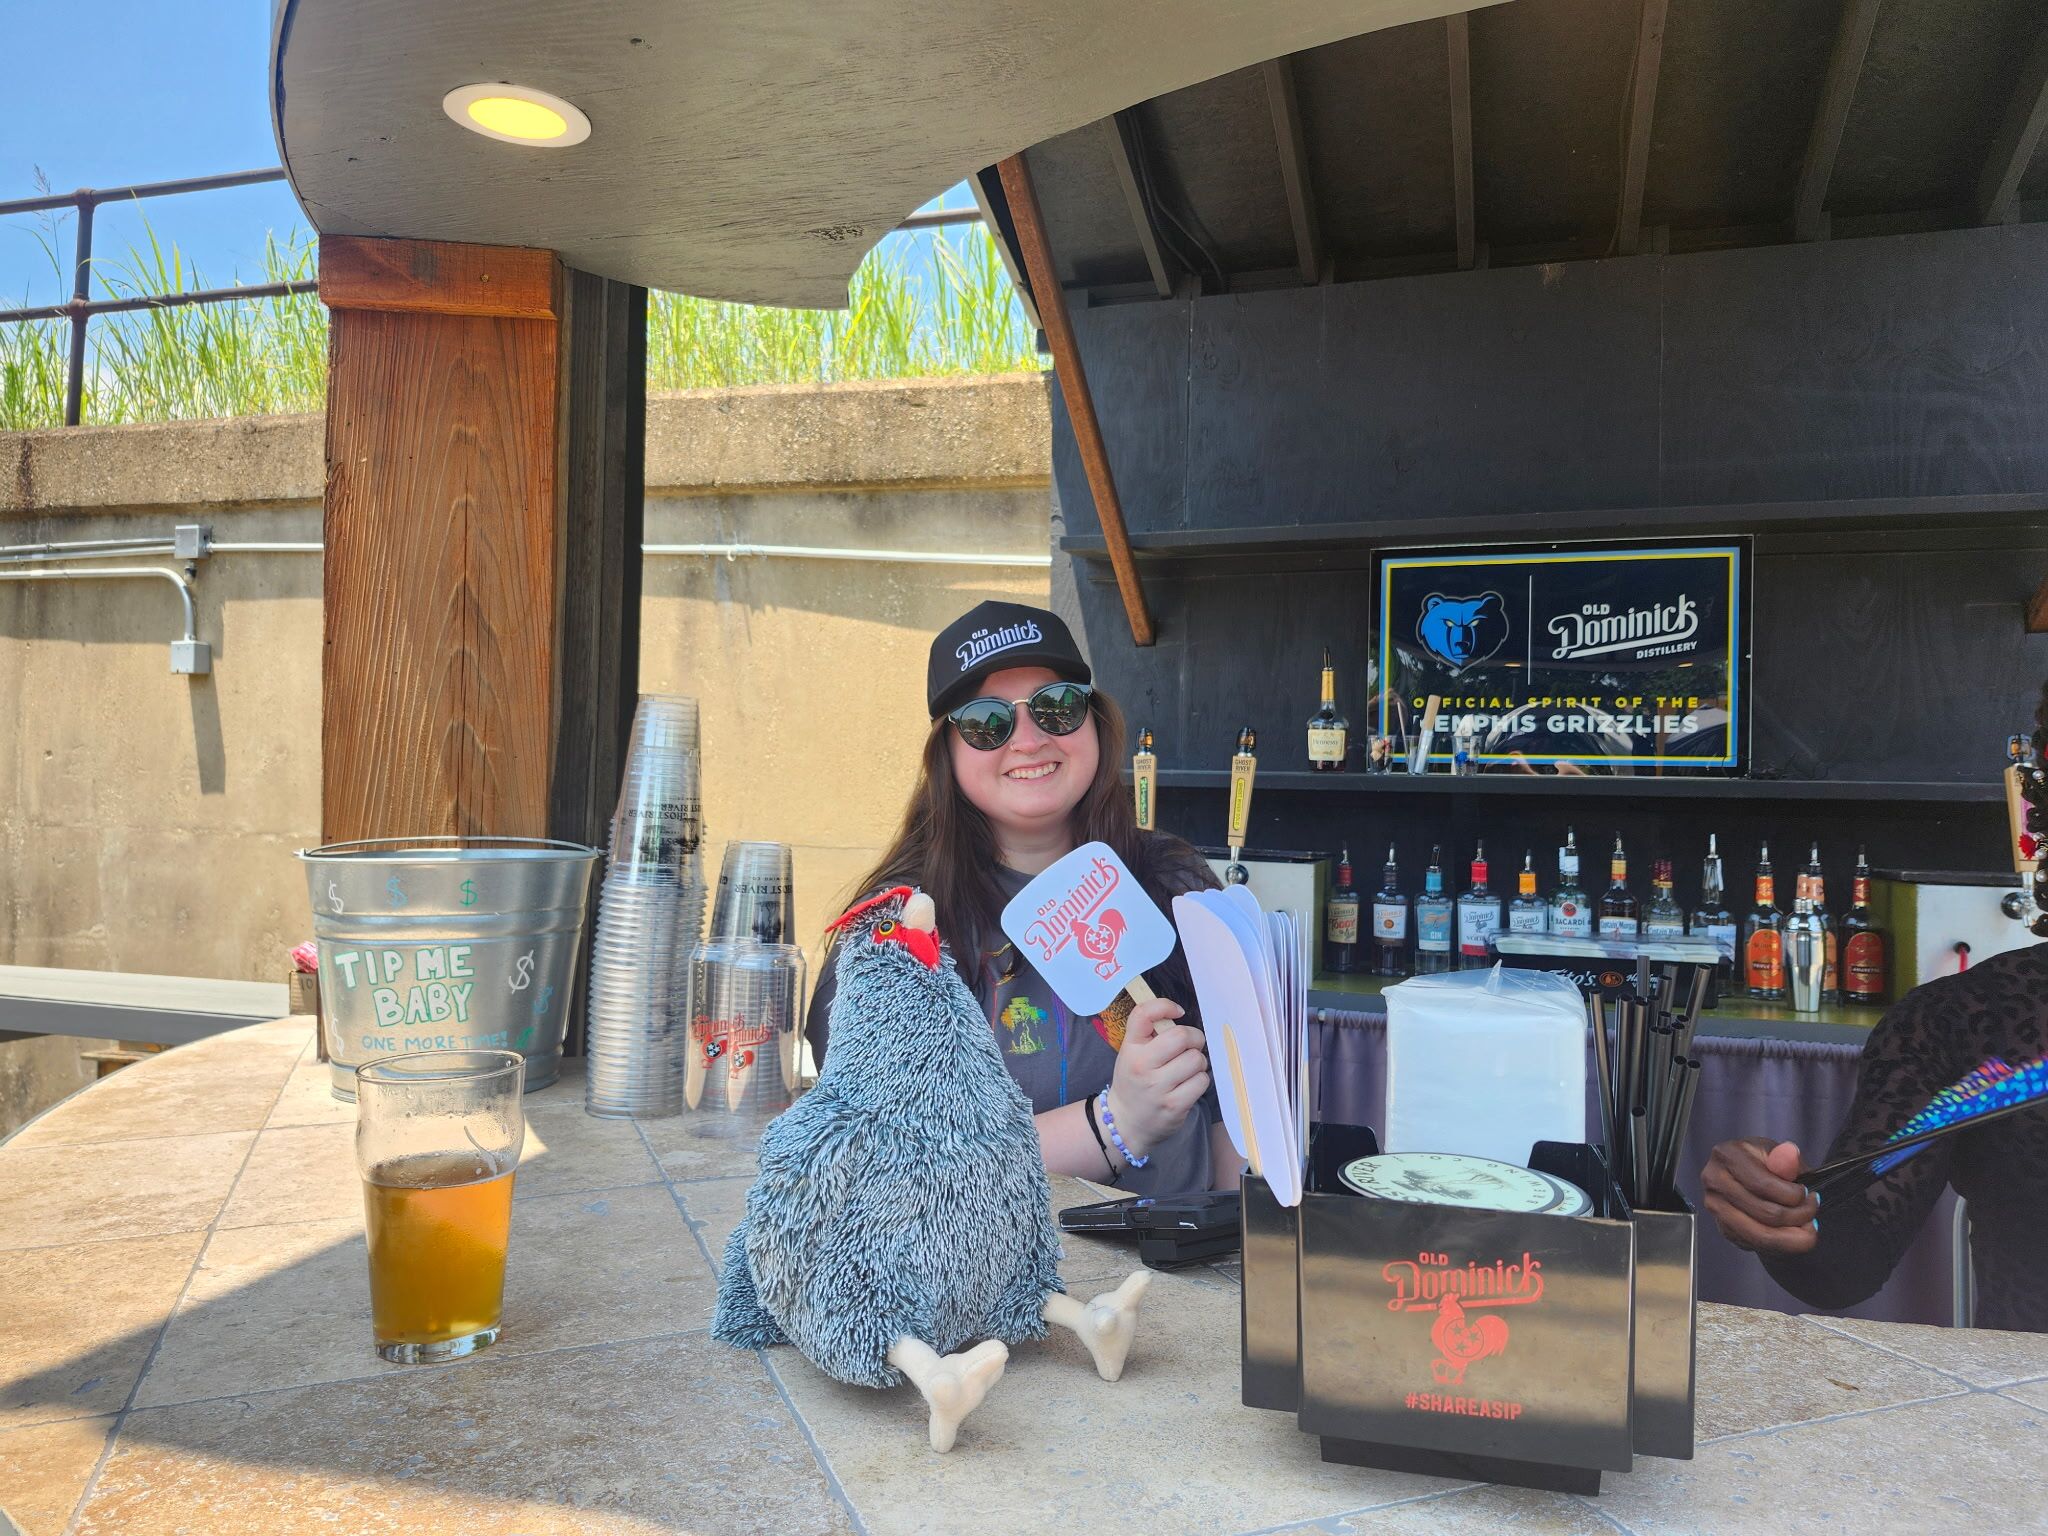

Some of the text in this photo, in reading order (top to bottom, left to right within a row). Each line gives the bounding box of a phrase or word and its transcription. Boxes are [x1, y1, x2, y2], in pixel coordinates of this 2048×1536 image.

[1582, 603, 1610, 616] OLD
[971, 628, 988, 640] OLD
[1547, 593, 1699, 660] Dominick
[956, 620, 1043, 672] Dominick
[1636, 640, 1698, 659] DISTILLERY
[1413, 696, 1699, 709] OFICIAL SPIRIT OF THE
[1413, 714, 1699, 734] EMPHIS GRIZZLIES
[1024, 856, 1120, 962] Dominick
[1037, 898, 1057, 917] OLD
[335, 944, 474, 989] TIP ME
[373, 982, 473, 1027] BABY
[361, 1035, 396, 1051] ONE
[405, 1035, 455, 1050] MORE
[1352, 1162, 1382, 1185] RIVER
[1418, 1252, 1449, 1265] OLD
[1382, 1252, 1544, 1312] Dominick
[1404, 1391, 1522, 1420] #SHAREASIP
